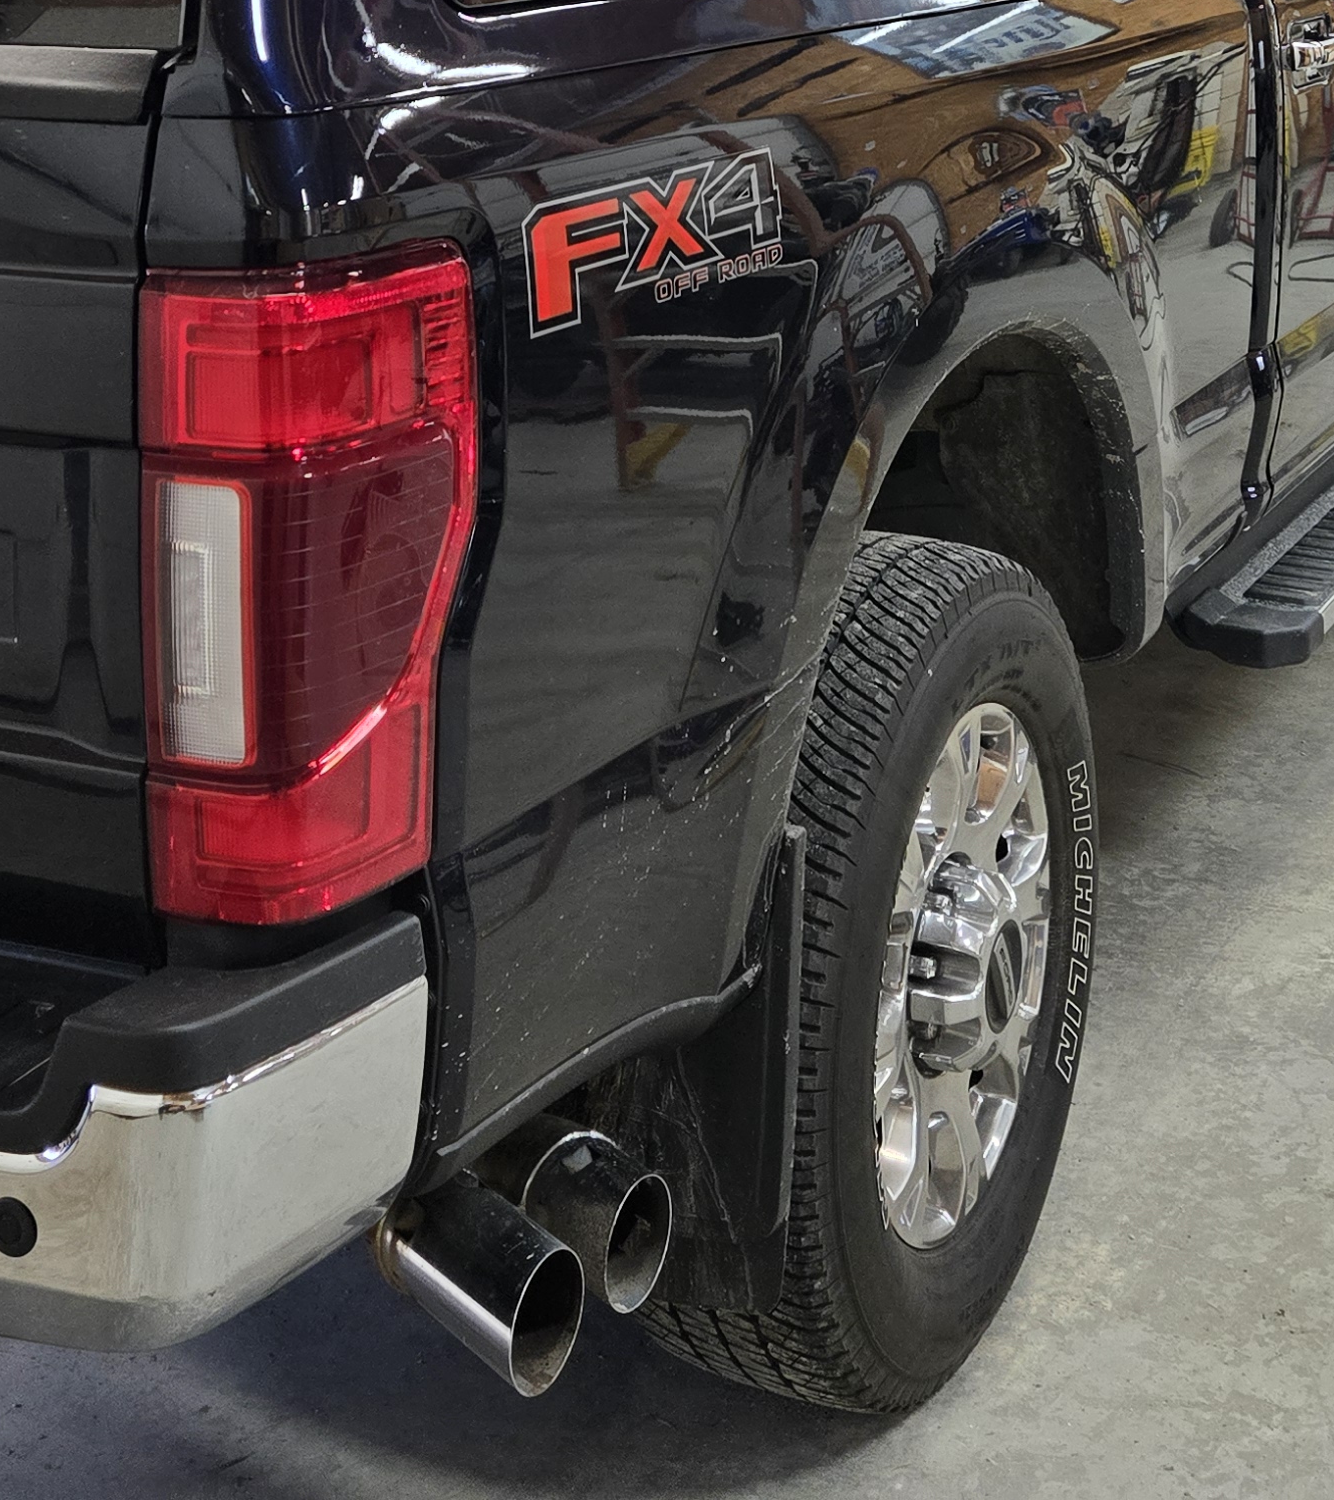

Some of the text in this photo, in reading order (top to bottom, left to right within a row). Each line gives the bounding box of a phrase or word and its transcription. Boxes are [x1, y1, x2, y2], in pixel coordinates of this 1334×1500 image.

[520, 146, 783, 340] FX4
[654, 243, 783, 304] OFF ROAD
[1055, 760, 1095, 1083] MICHELIN
